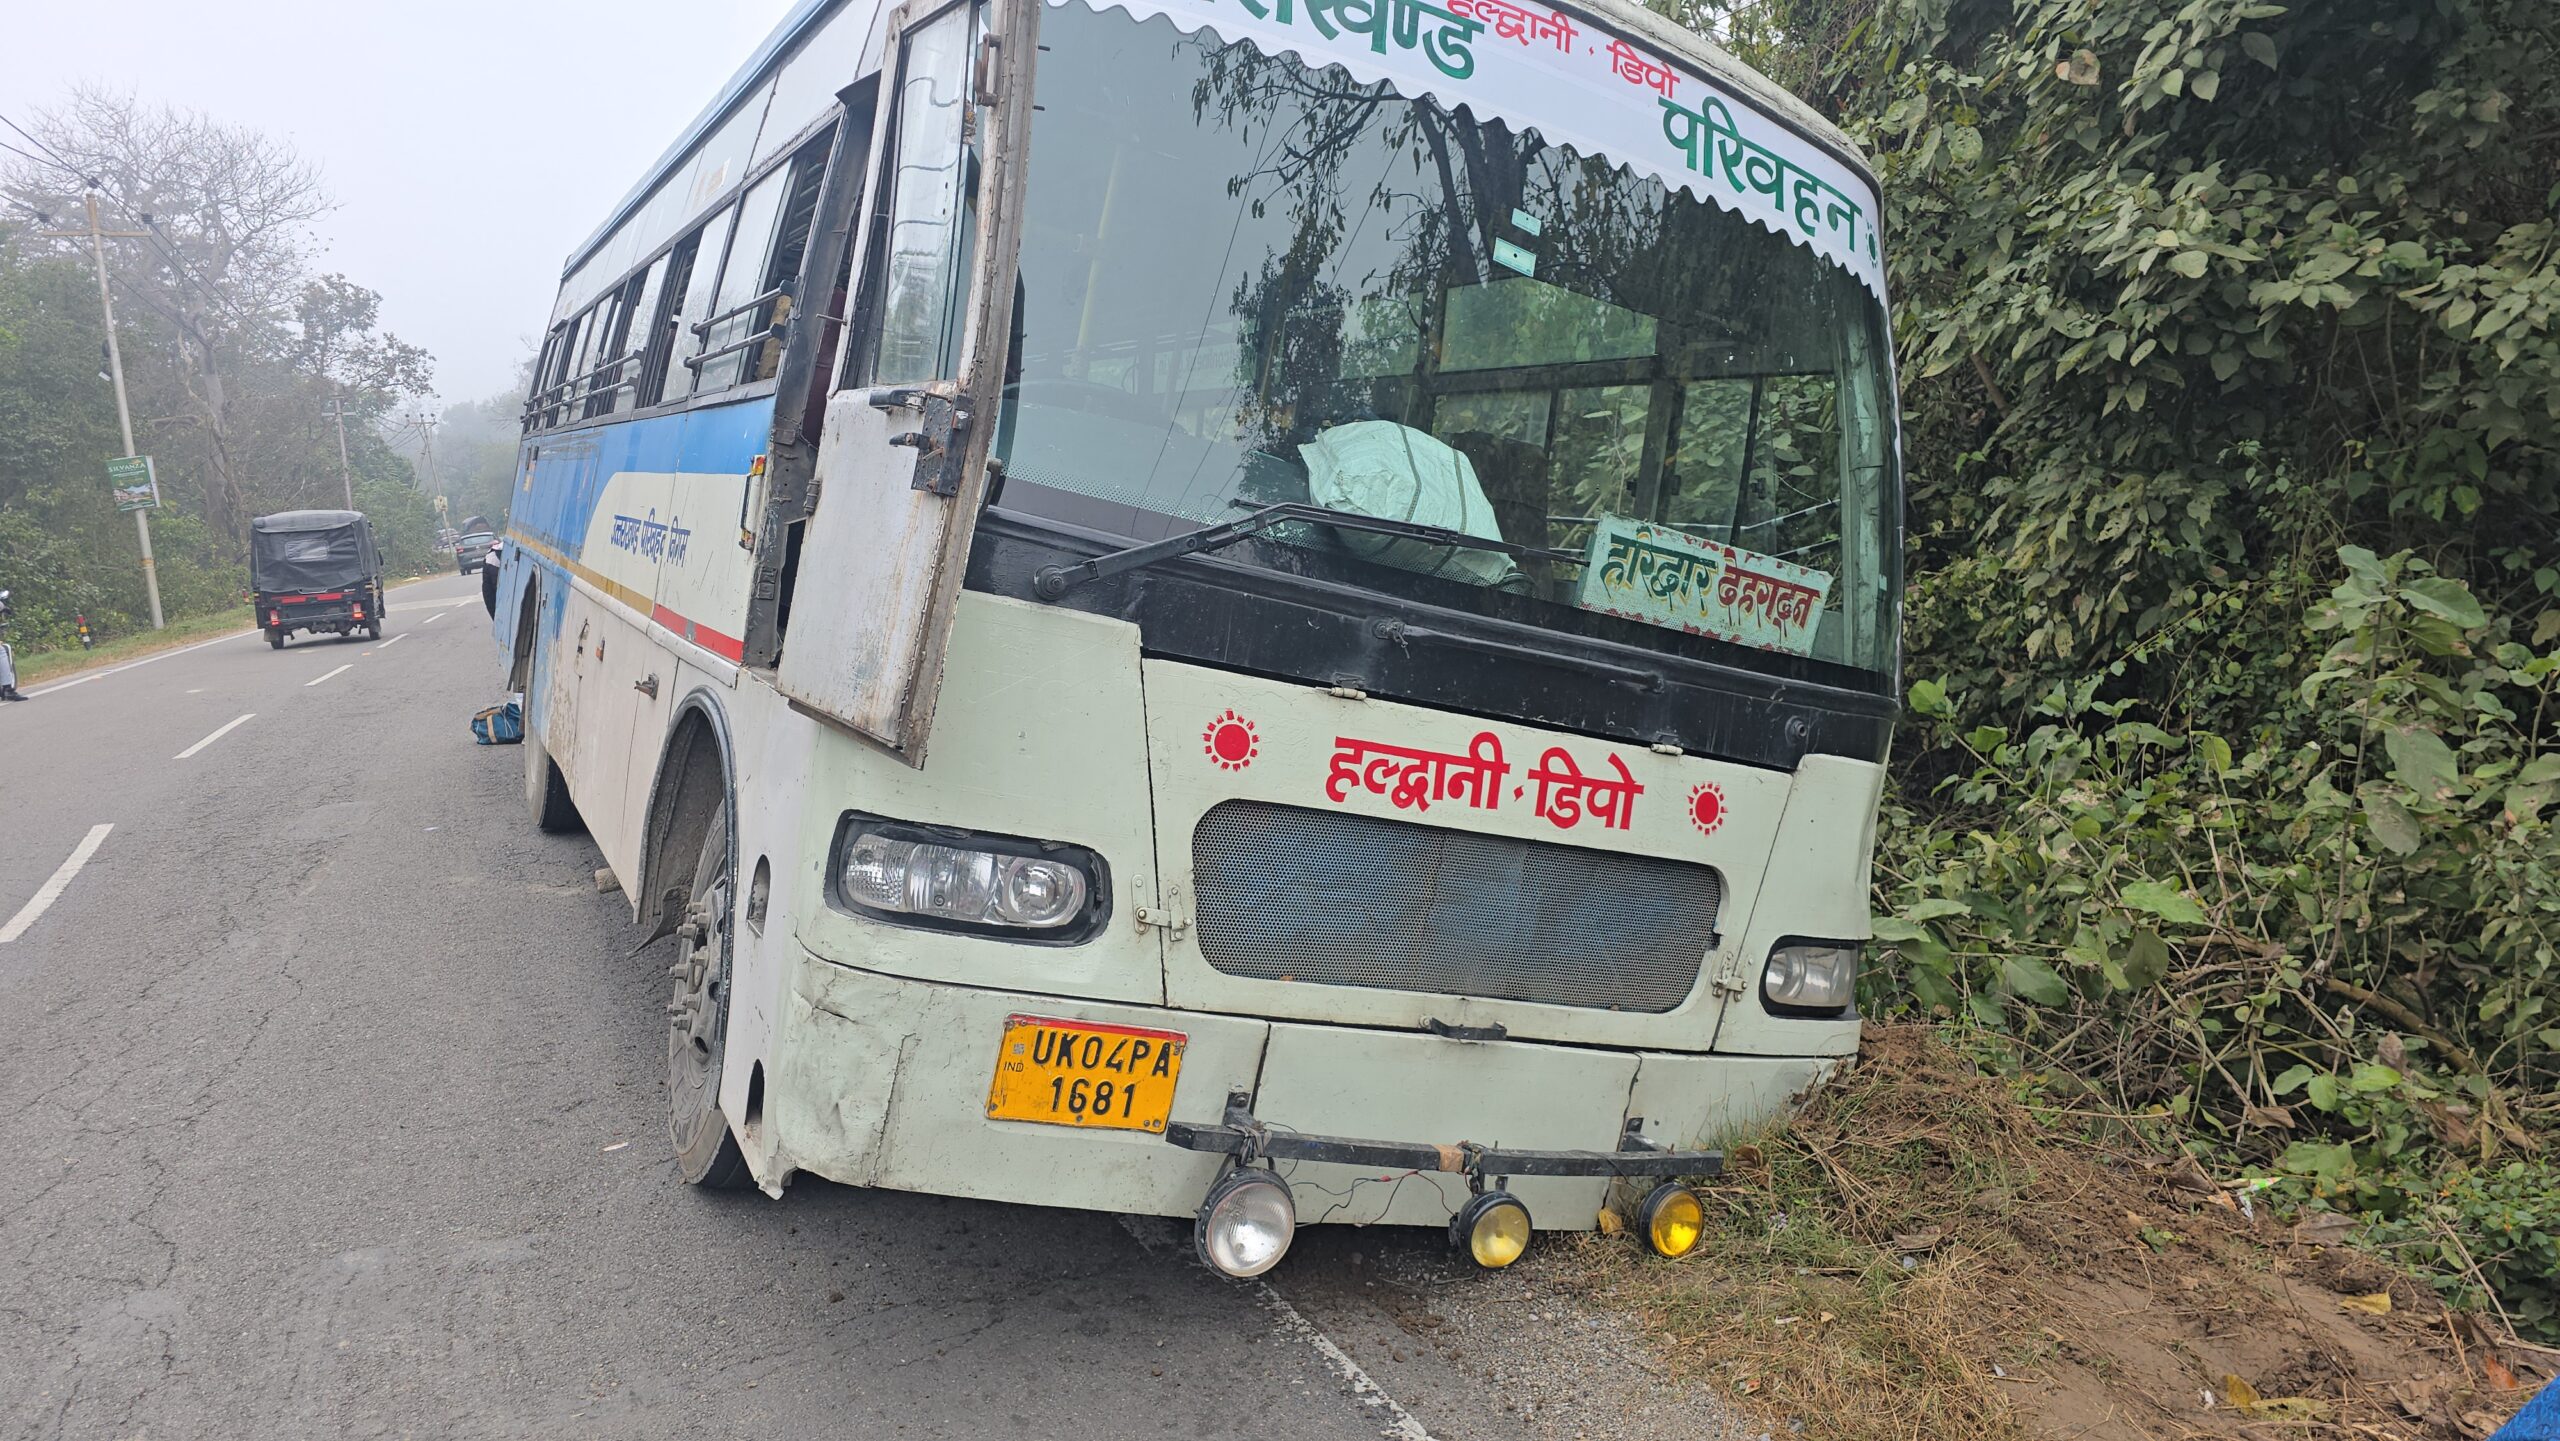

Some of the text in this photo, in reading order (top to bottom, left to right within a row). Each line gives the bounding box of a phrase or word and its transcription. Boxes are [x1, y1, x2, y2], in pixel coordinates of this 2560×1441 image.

[1606, 39, 1681, 99] डिपो
[1658, 96, 1863, 253] परिवहन
[1527, 746, 1645, 830] डिपो
[1003, 1061, 1025, 1072] IND
[1032, 1029, 1171, 1077] UK04PA
[1051, 1075, 1136, 1118] 1681
